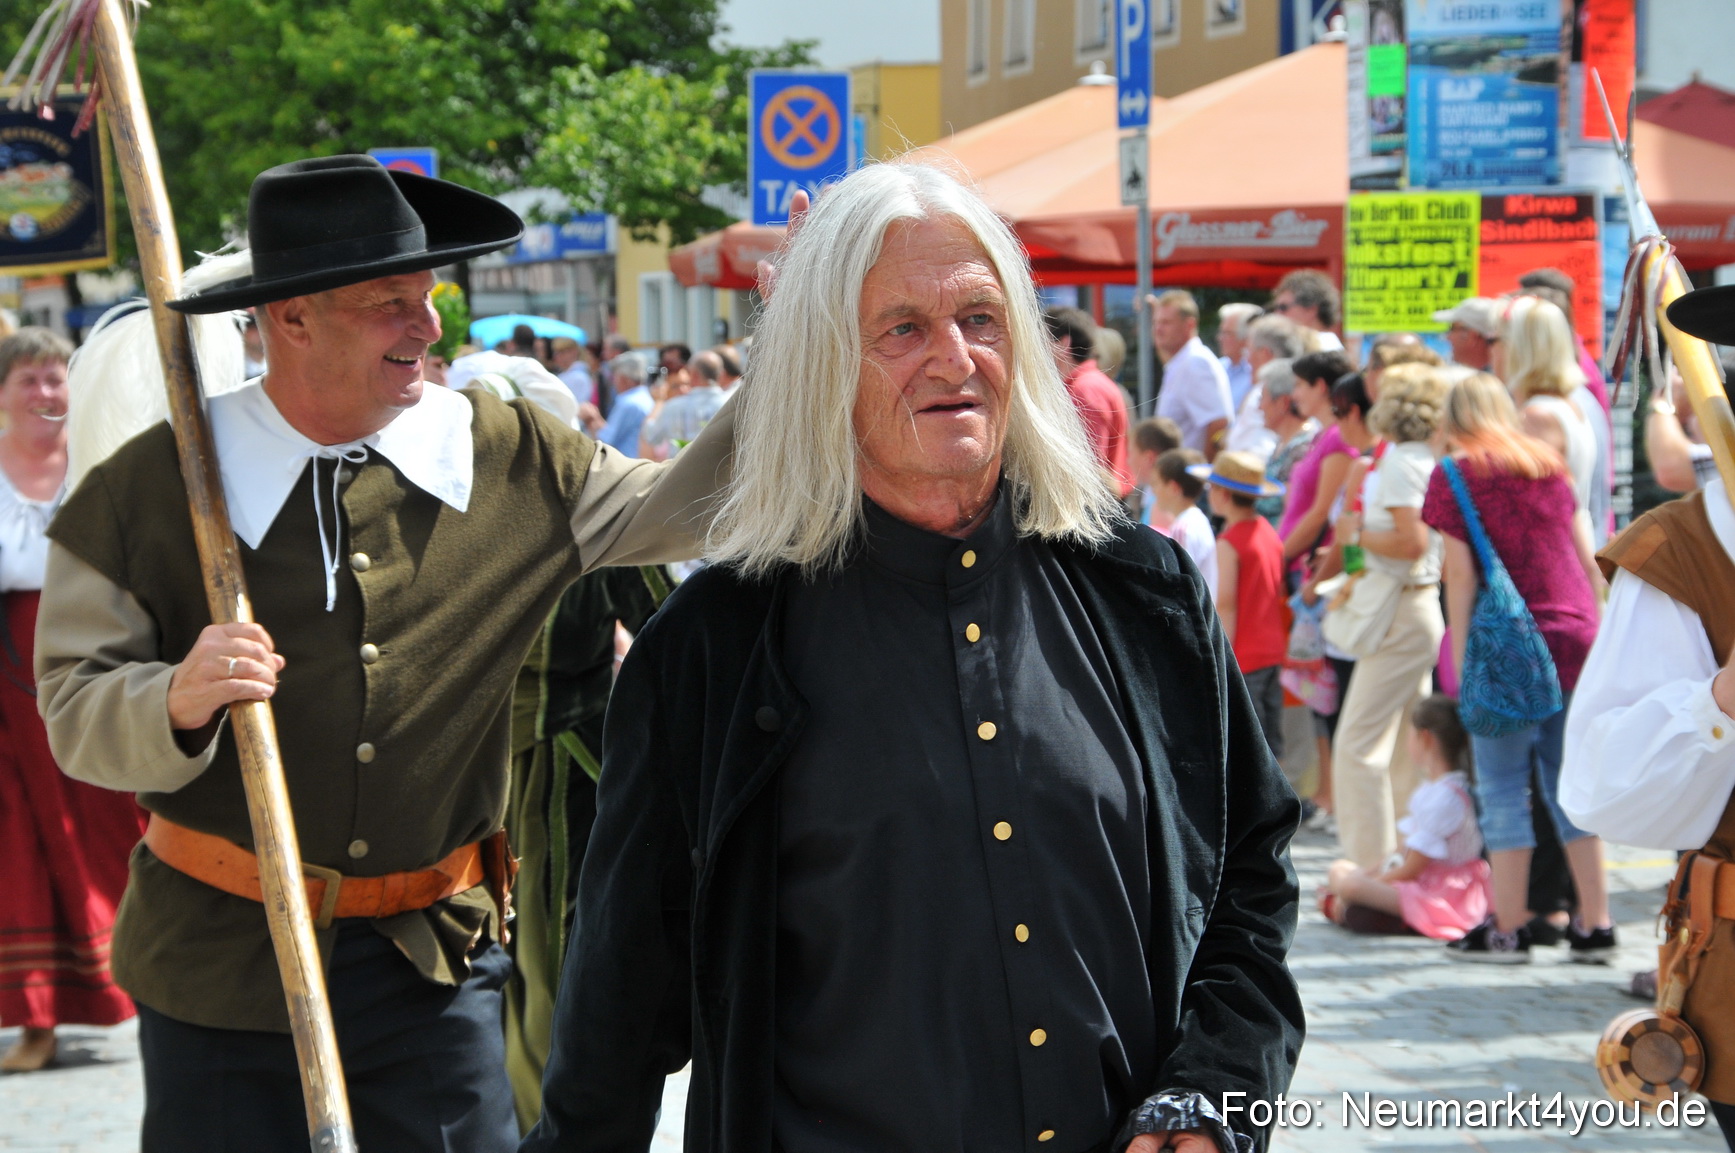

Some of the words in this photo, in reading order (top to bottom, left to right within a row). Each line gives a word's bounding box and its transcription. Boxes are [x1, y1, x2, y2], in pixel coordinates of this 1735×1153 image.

[1441, 5, 1499, 22] LIEDER
[1517, 3, 1547, 19] SEE
[1504, 193, 1578, 216] Kirwa
